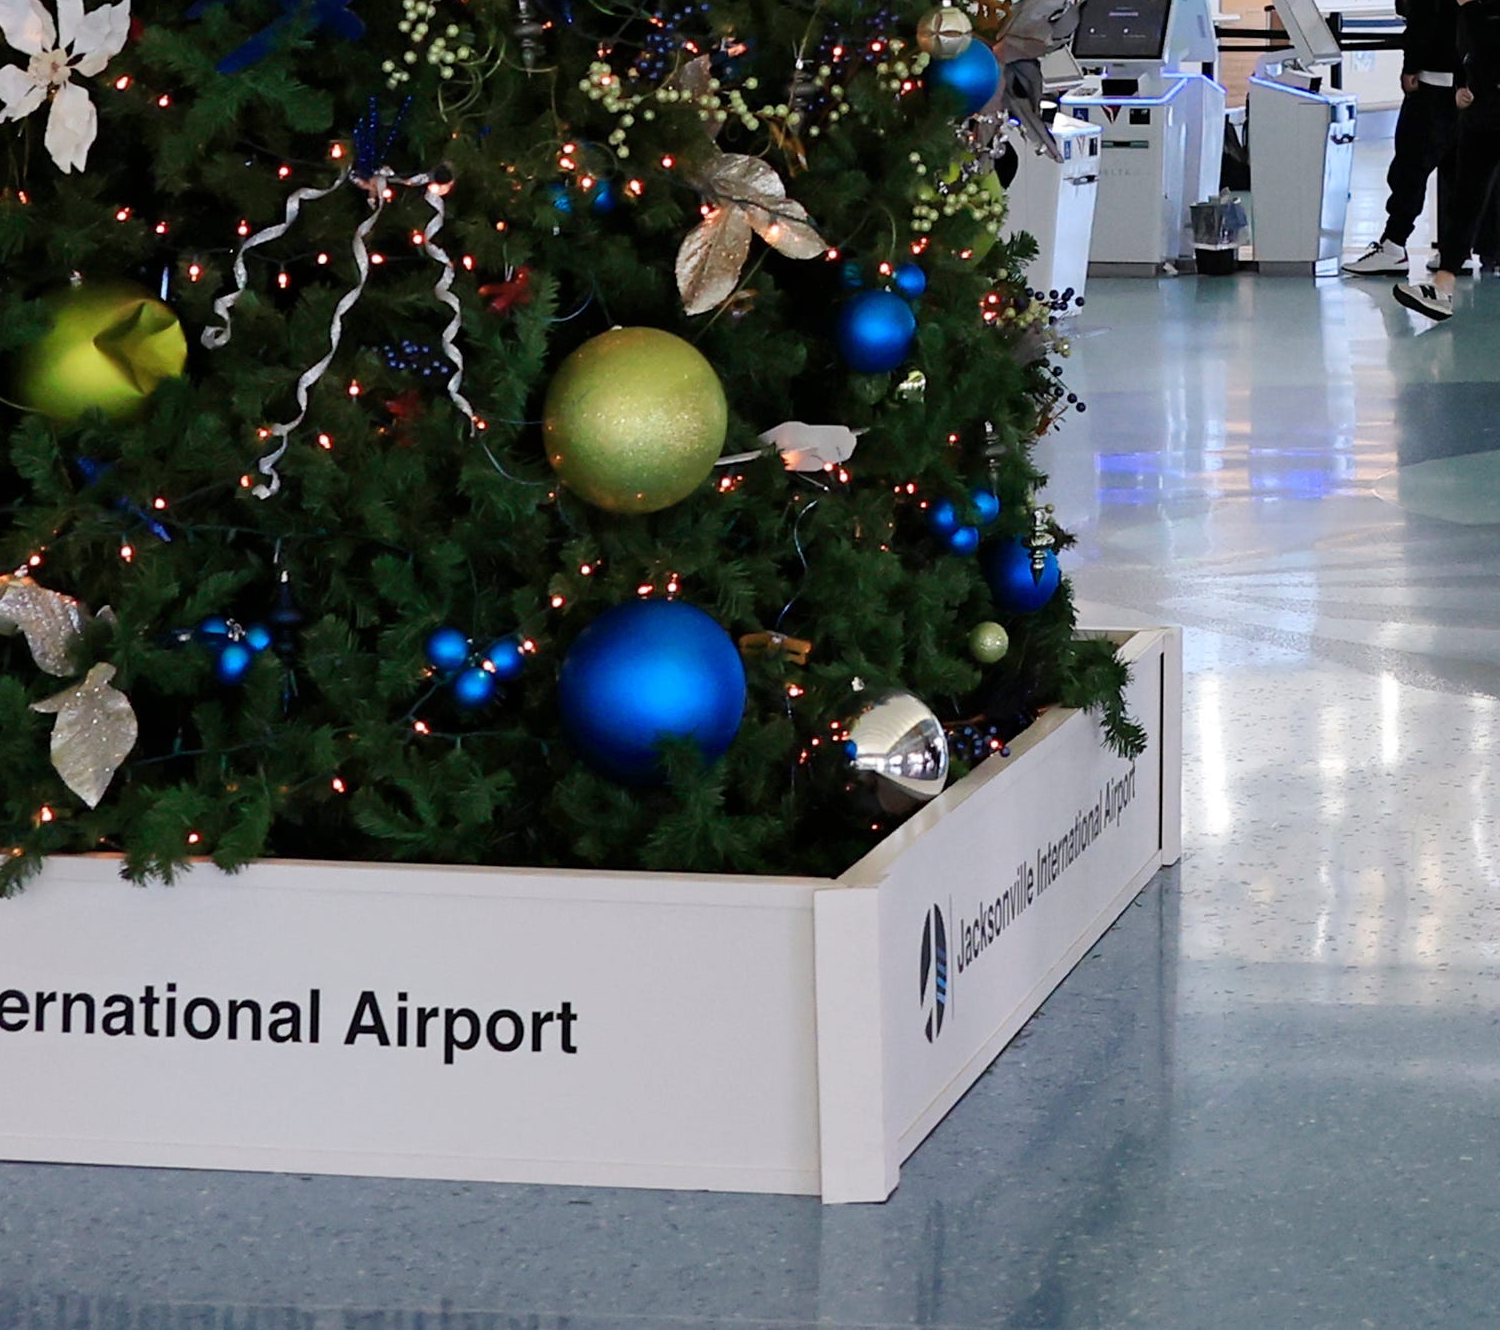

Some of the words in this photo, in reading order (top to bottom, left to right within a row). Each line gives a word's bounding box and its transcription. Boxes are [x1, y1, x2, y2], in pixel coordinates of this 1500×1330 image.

[956, 860, 1035, 974] Jacksonville
[1035, 788, 1103, 898] International
[1102, 764, 1137, 829] Airport
[343, 990, 579, 1065] Airport
